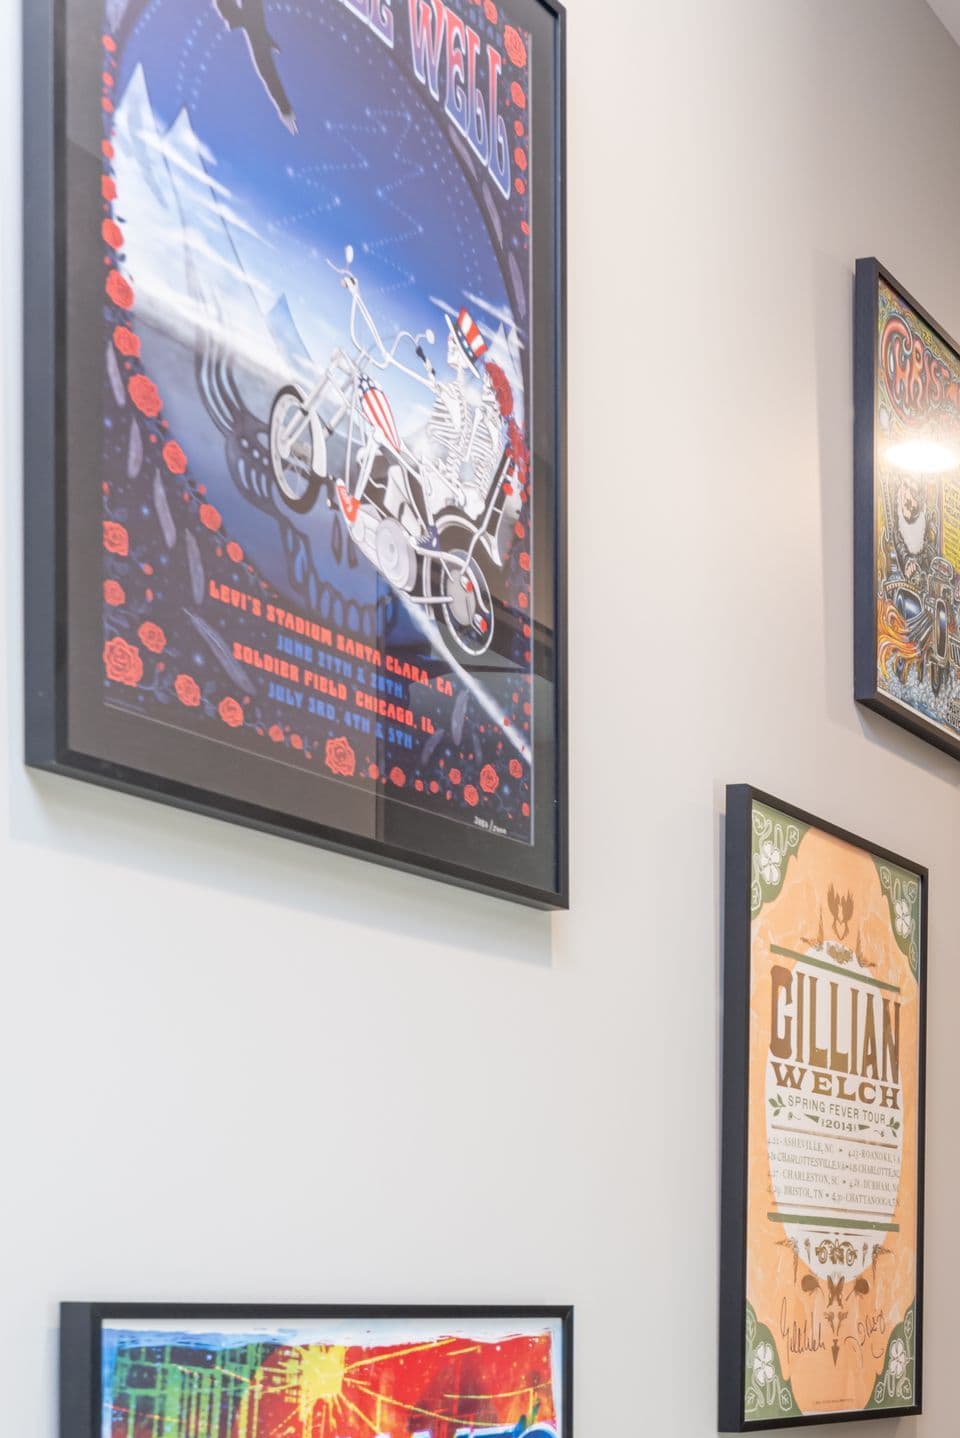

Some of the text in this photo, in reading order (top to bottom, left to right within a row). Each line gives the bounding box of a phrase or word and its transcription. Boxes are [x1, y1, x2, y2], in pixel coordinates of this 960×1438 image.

[408, 0, 511, 200] WELL
[209, 580, 453, 697] LEVI'S STADIUM SANTA CLARA, CA
[277, 634, 403, 699] JUNE 27TH & 28TH
[233, 641, 435, 735] SOLDIER FIELD CHICAGO, IL
[268, 682, 303, 709] JULY
[344, 711, 370, 734] 4TH
[375, 721, 384, 740] &
[388, 727, 413, 750] 5TH
[770, 965, 901, 1084] GILLIAN
[770, 1061, 900, 1110] WELCH
[787, 1095, 886, 1124] SPRING FEVER TOUR
[825, 1120, 852, 1132] 2014
